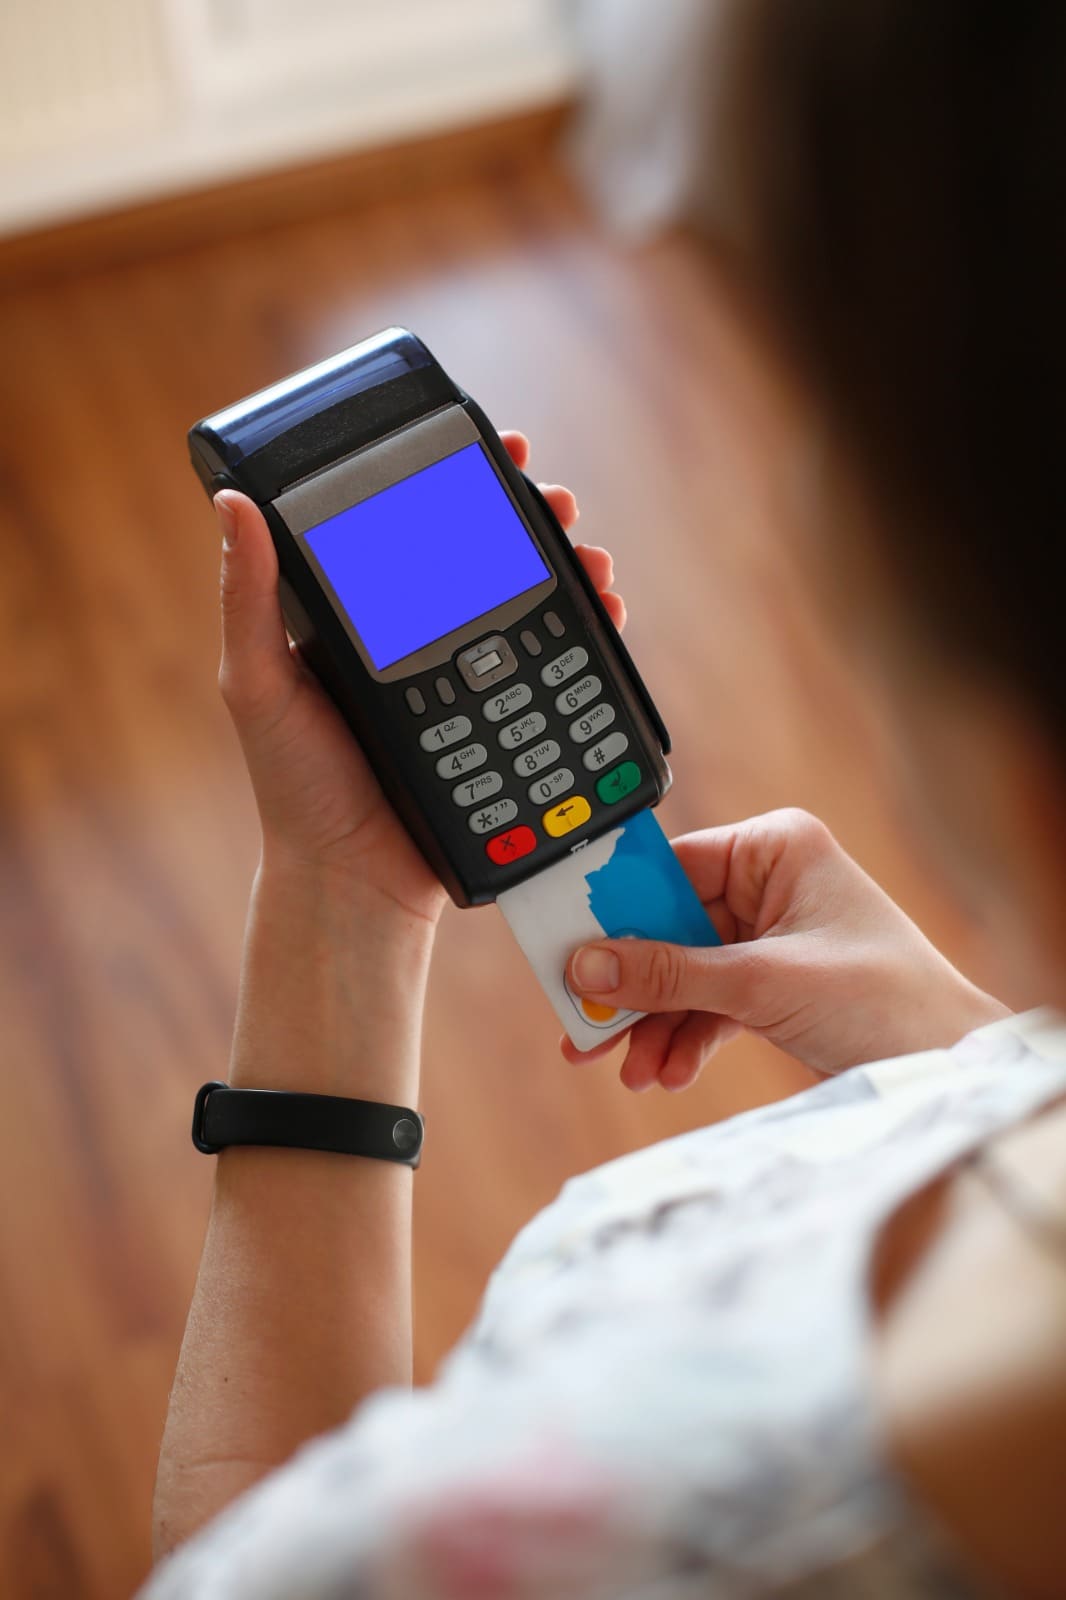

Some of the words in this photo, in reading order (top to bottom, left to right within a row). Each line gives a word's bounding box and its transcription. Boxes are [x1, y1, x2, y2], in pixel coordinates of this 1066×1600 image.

[551, 665, 564, 679] 3
[560, 653, 575, 667] DEF
[495, 699, 509, 714] 2
[505, 688, 522, 701] ABC
[566, 693, 578, 708] 6
[511, 726, 522, 742] 5
[580, 720, 592, 735] 9
[434, 728, 445, 743] 1
[451, 756, 462, 770] 4
[524, 755, 537, 770] 8
[465, 784, 475, 799] 7
[540, 782, 551, 798] 0
